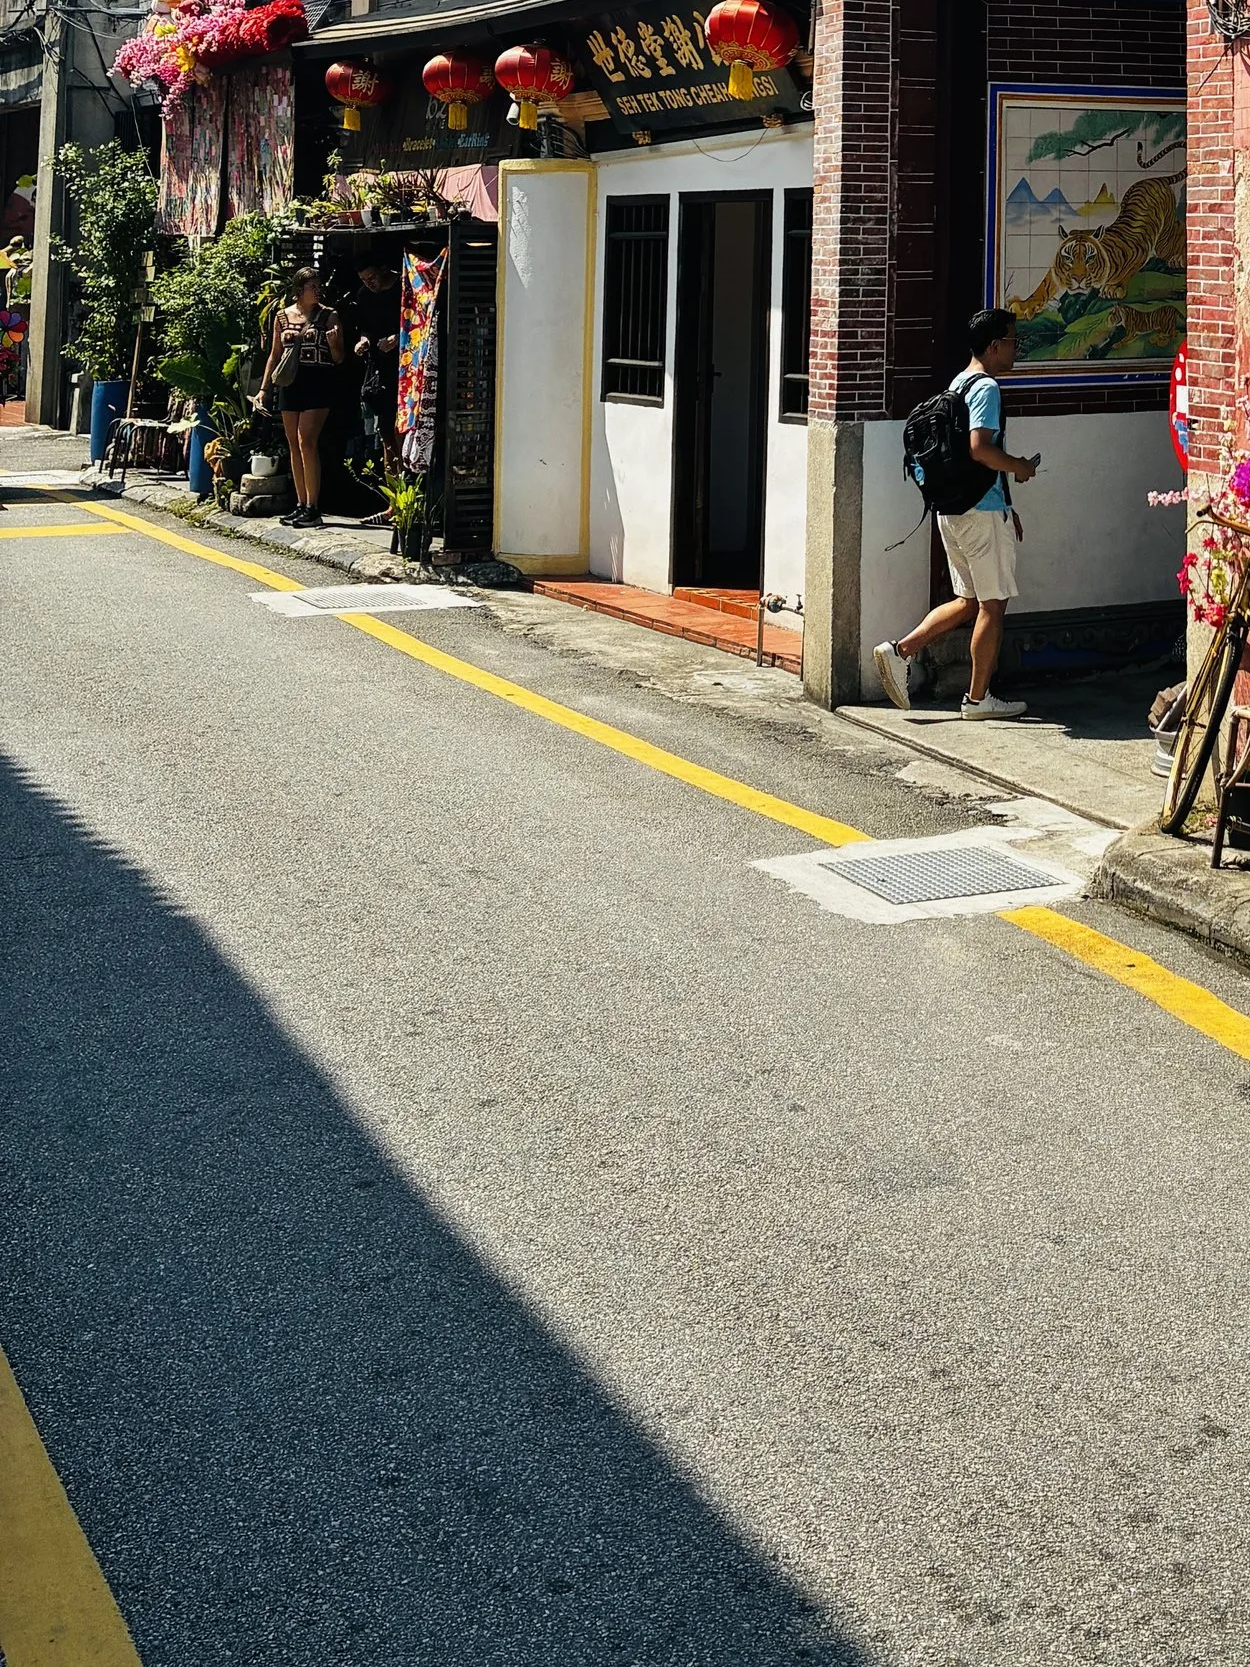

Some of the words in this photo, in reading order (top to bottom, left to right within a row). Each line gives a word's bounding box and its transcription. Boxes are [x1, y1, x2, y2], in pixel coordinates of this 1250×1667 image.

[586, 10, 732, 84] 世德堂謝
[351, 69, 379, 97] 謝
[615, 96, 642, 116] SEH
[638, 92, 665, 113] TEK
[657, 86, 694, 110] TONG
[690, 81, 733, 106] CHEAH
